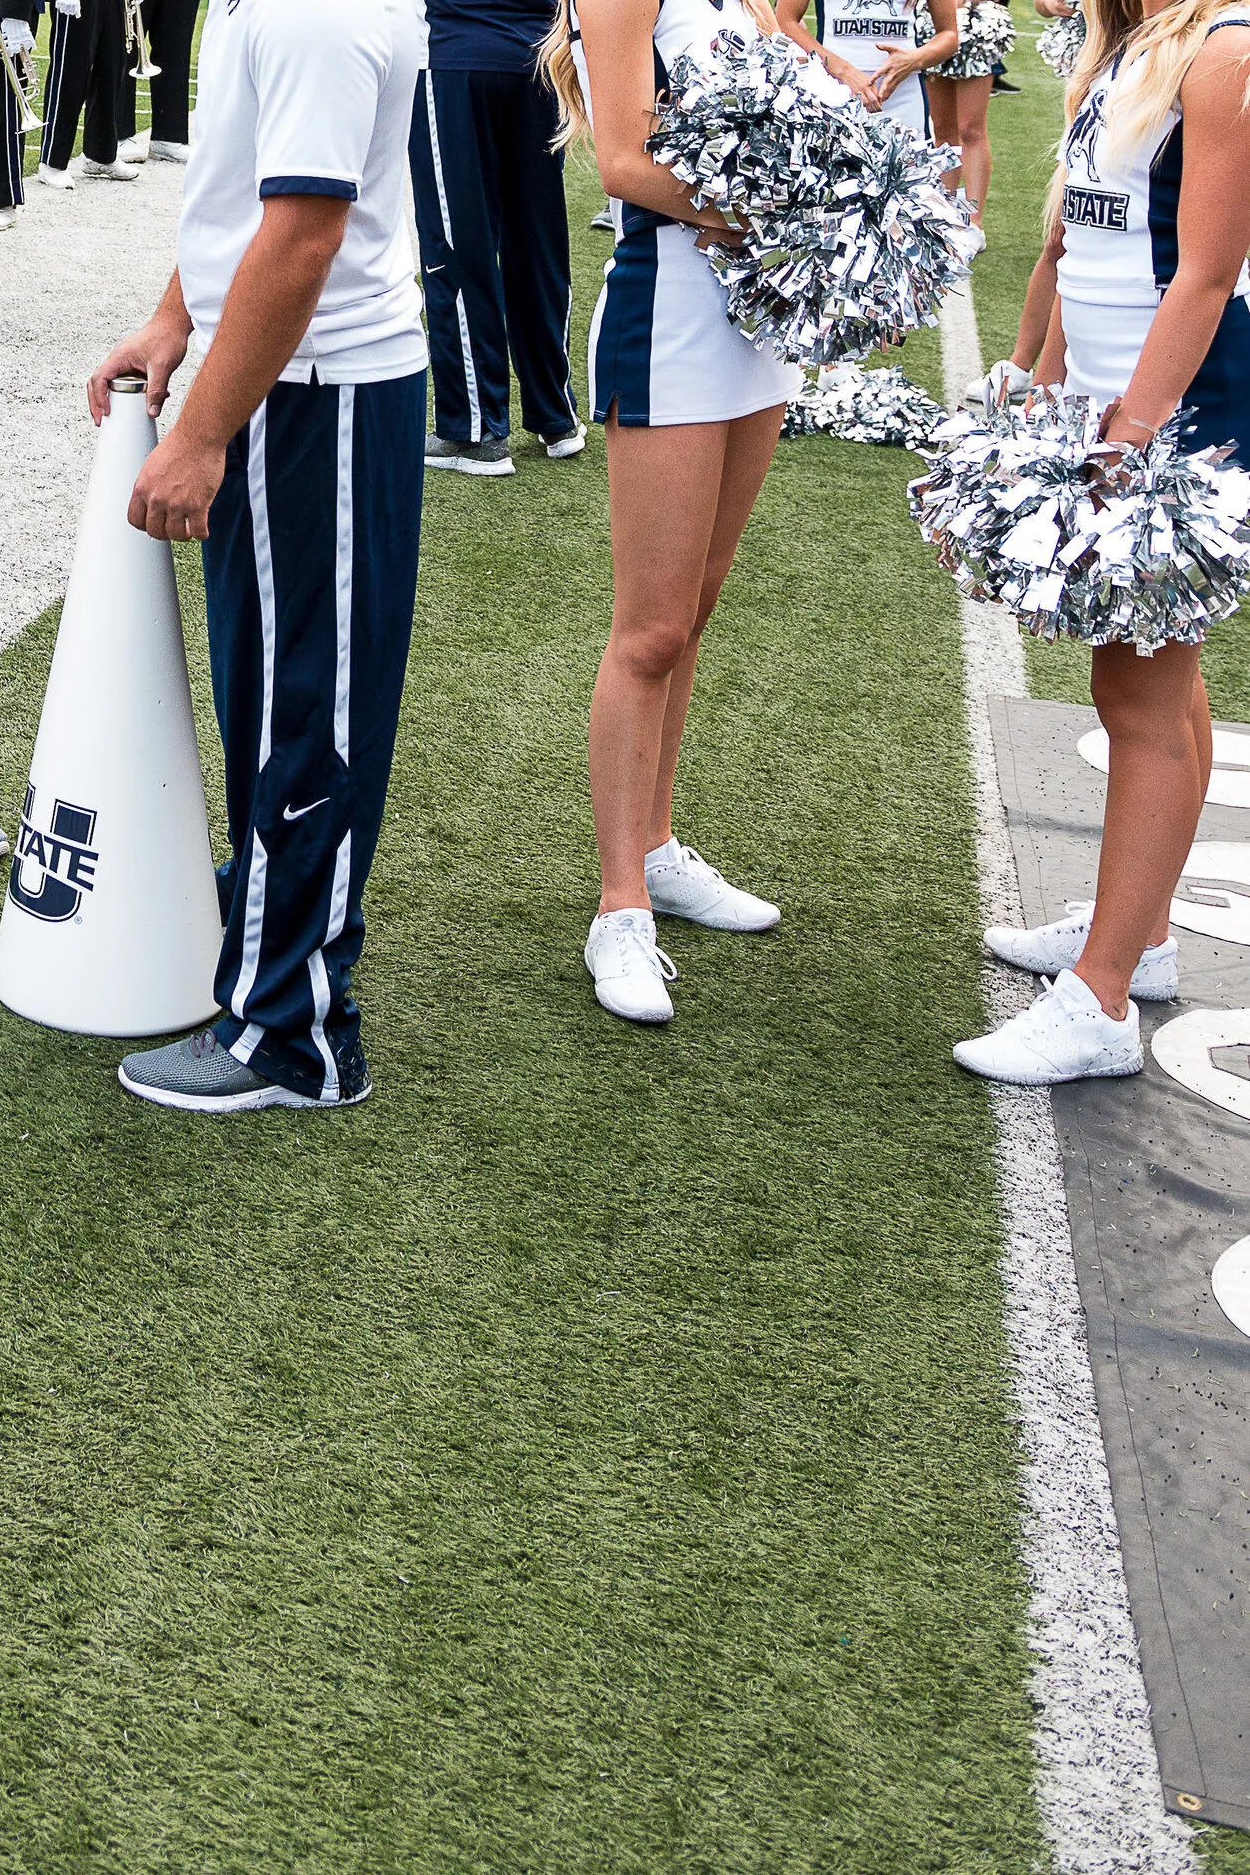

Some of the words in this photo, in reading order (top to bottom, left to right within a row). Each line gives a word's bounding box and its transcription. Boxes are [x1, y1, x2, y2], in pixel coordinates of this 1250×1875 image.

[833, 18, 871, 37] UTAH
[871, 18, 910, 39] STATE
[1067, 186, 1130, 232] STATE
[20, 820, 99, 892] TATE
